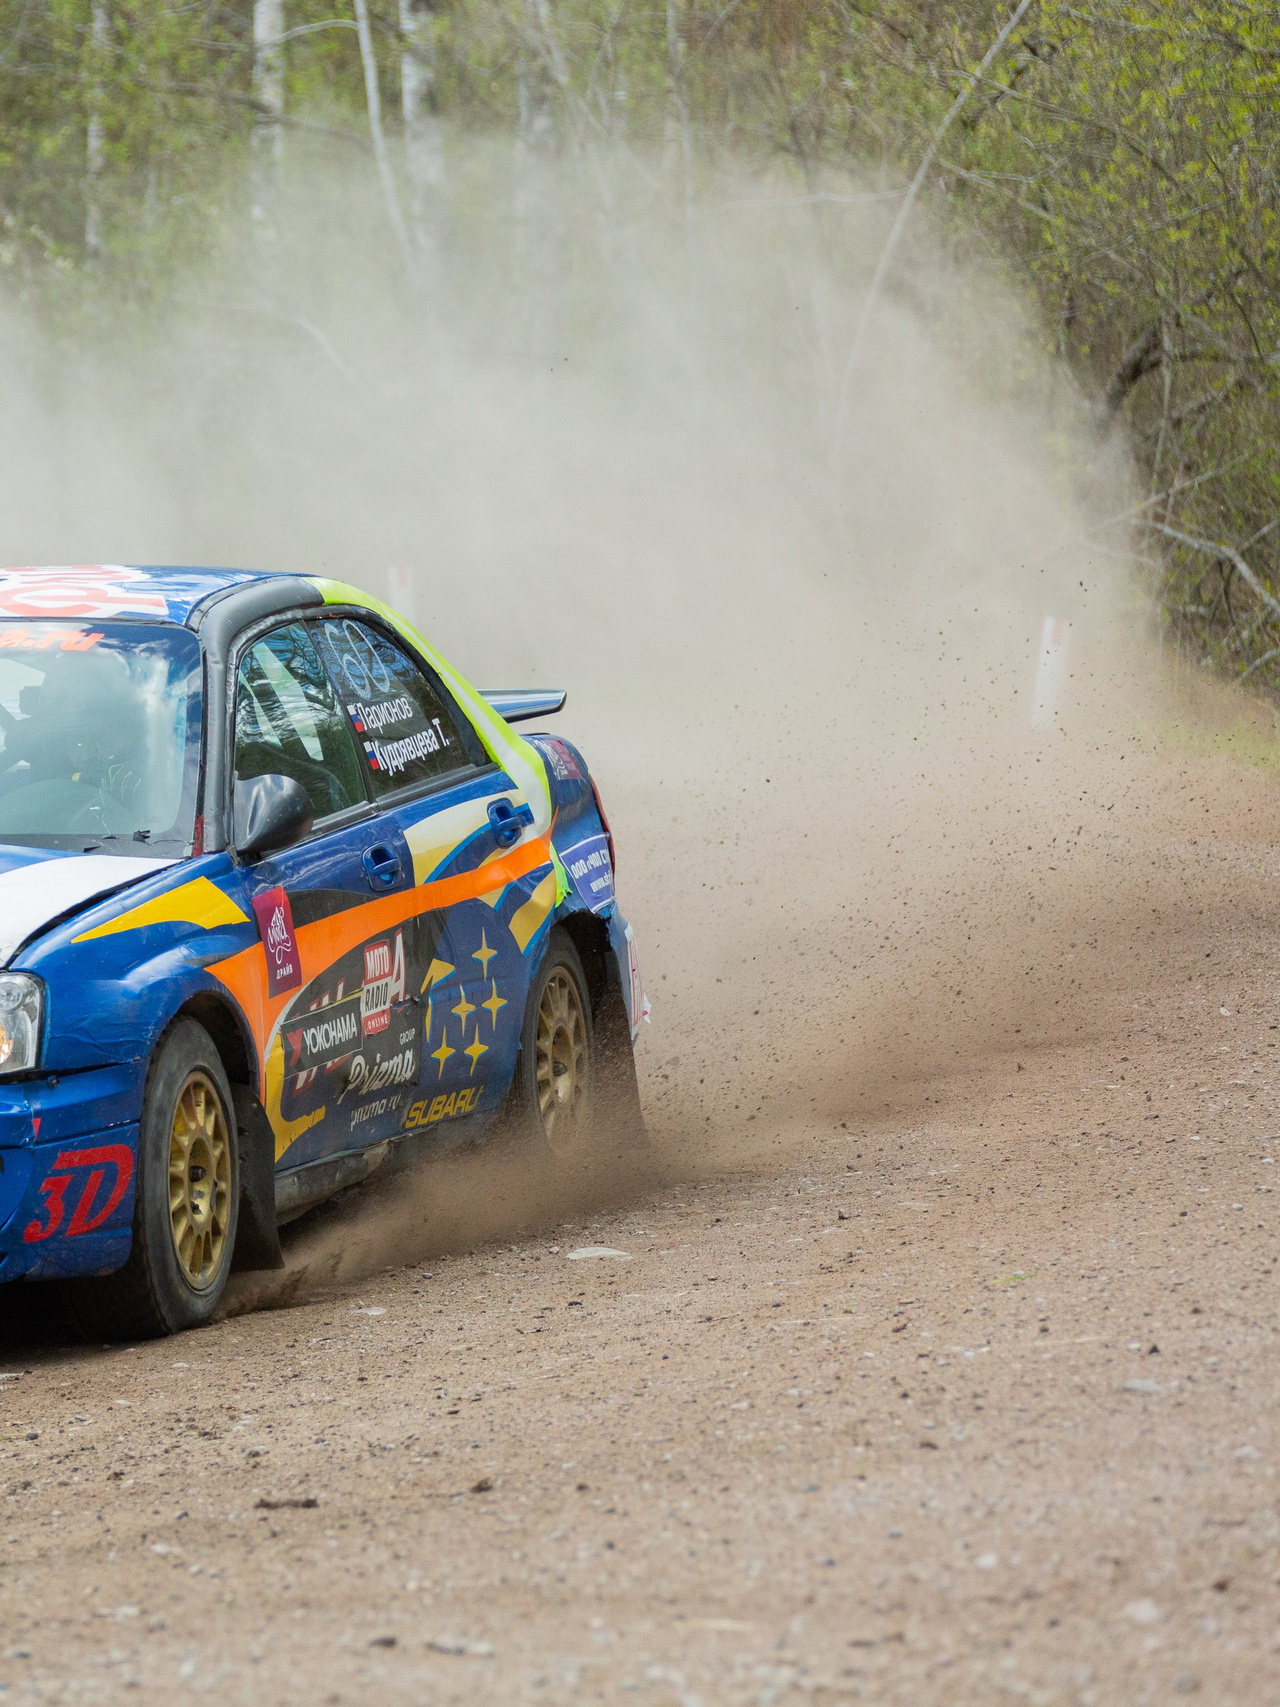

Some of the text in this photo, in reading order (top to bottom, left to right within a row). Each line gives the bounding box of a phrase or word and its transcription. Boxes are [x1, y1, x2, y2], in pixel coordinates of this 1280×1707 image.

[325, 619, 391, 701] 60
[357, 697, 413, 734] Ларионов
[370, 717, 450, 777] Кудрявцева Т.
[276, 963, 293, 980] ДРАЙВ
[365, 944, 390, 980] MOTO
[364, 981, 390, 1013] RADIO
[303, 1012, 358, 1056] YOKOHAMA
[367, 1013, 389, 1030] ONLINE
[399, 1028, 416, 1046] GROUP
[405, 1085, 485, 1129] SUBARU
[23, 1143, 134, 1244] 3D
